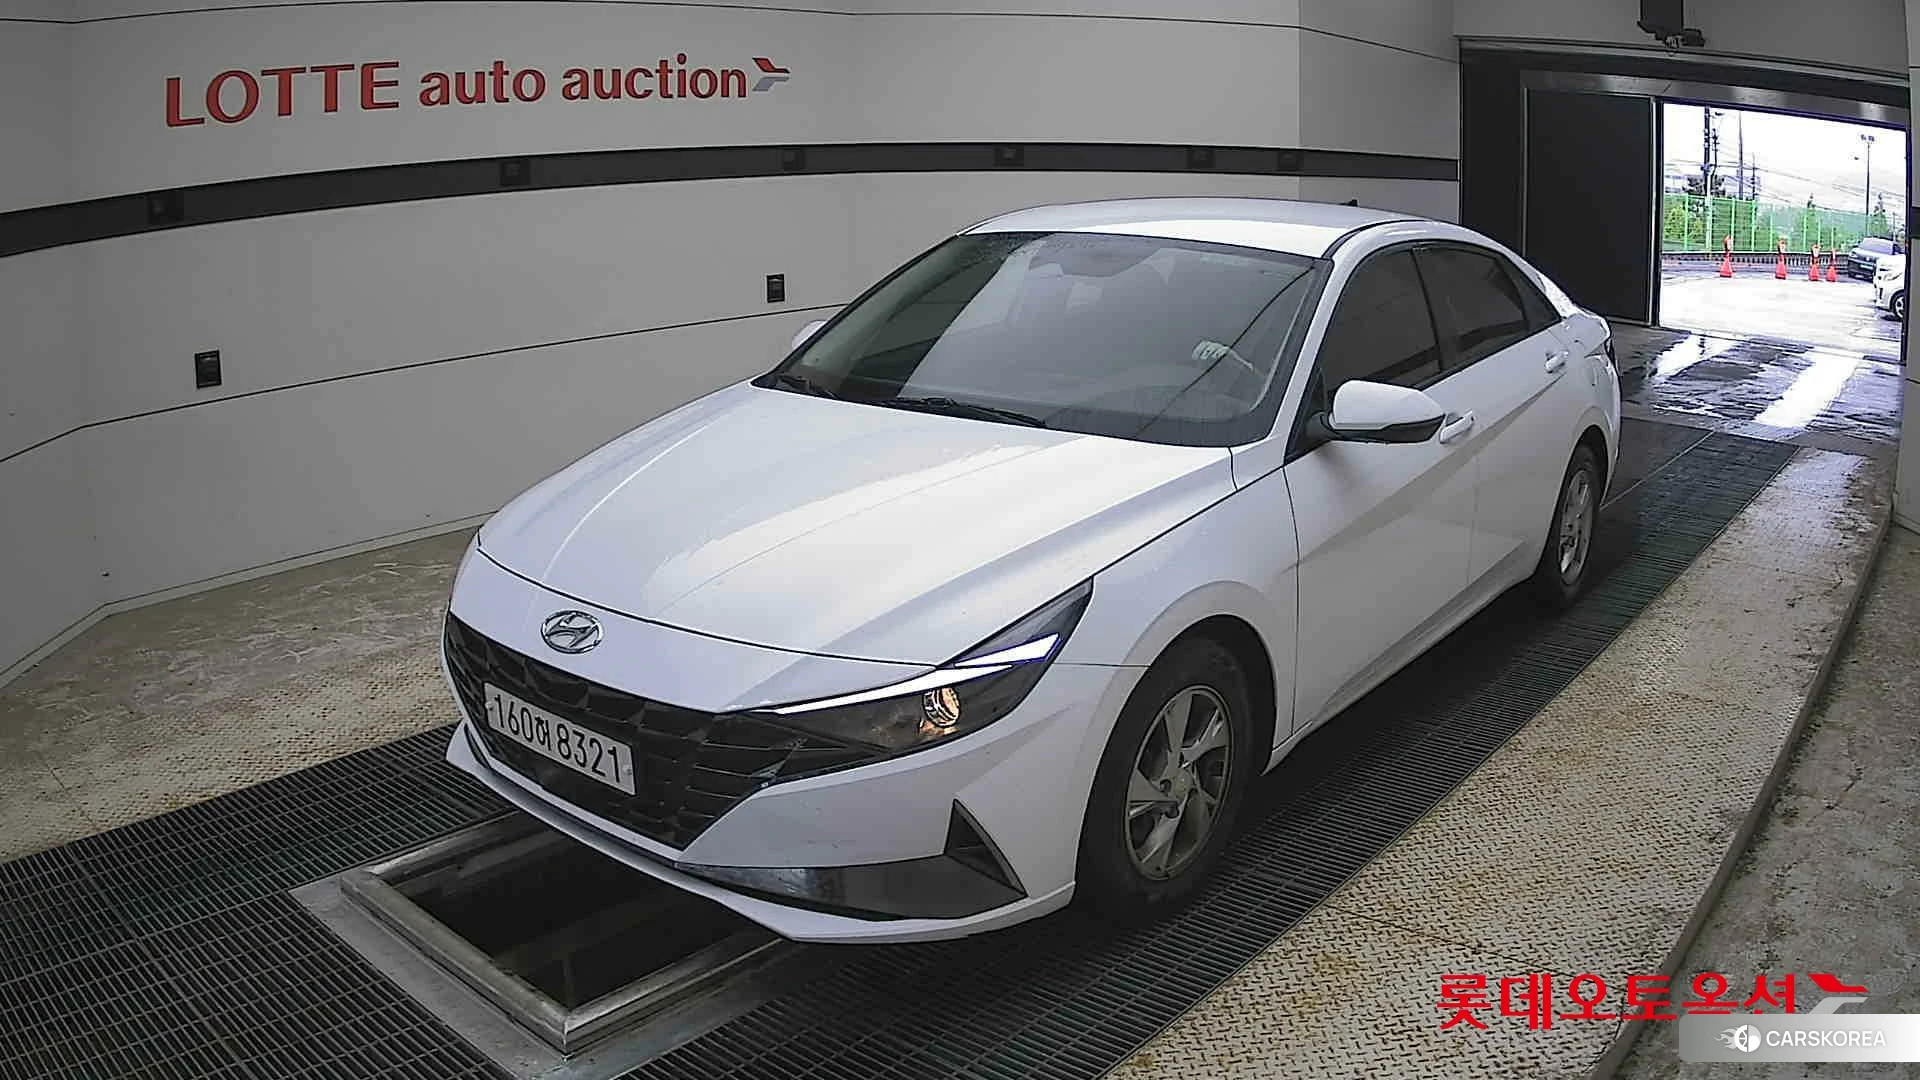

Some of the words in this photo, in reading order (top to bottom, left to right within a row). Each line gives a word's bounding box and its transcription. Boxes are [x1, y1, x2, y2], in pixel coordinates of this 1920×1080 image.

[165, 61, 400, 128] LOTTE
[418, 60, 546, 107] auto
[561, 53, 747, 100] auction
